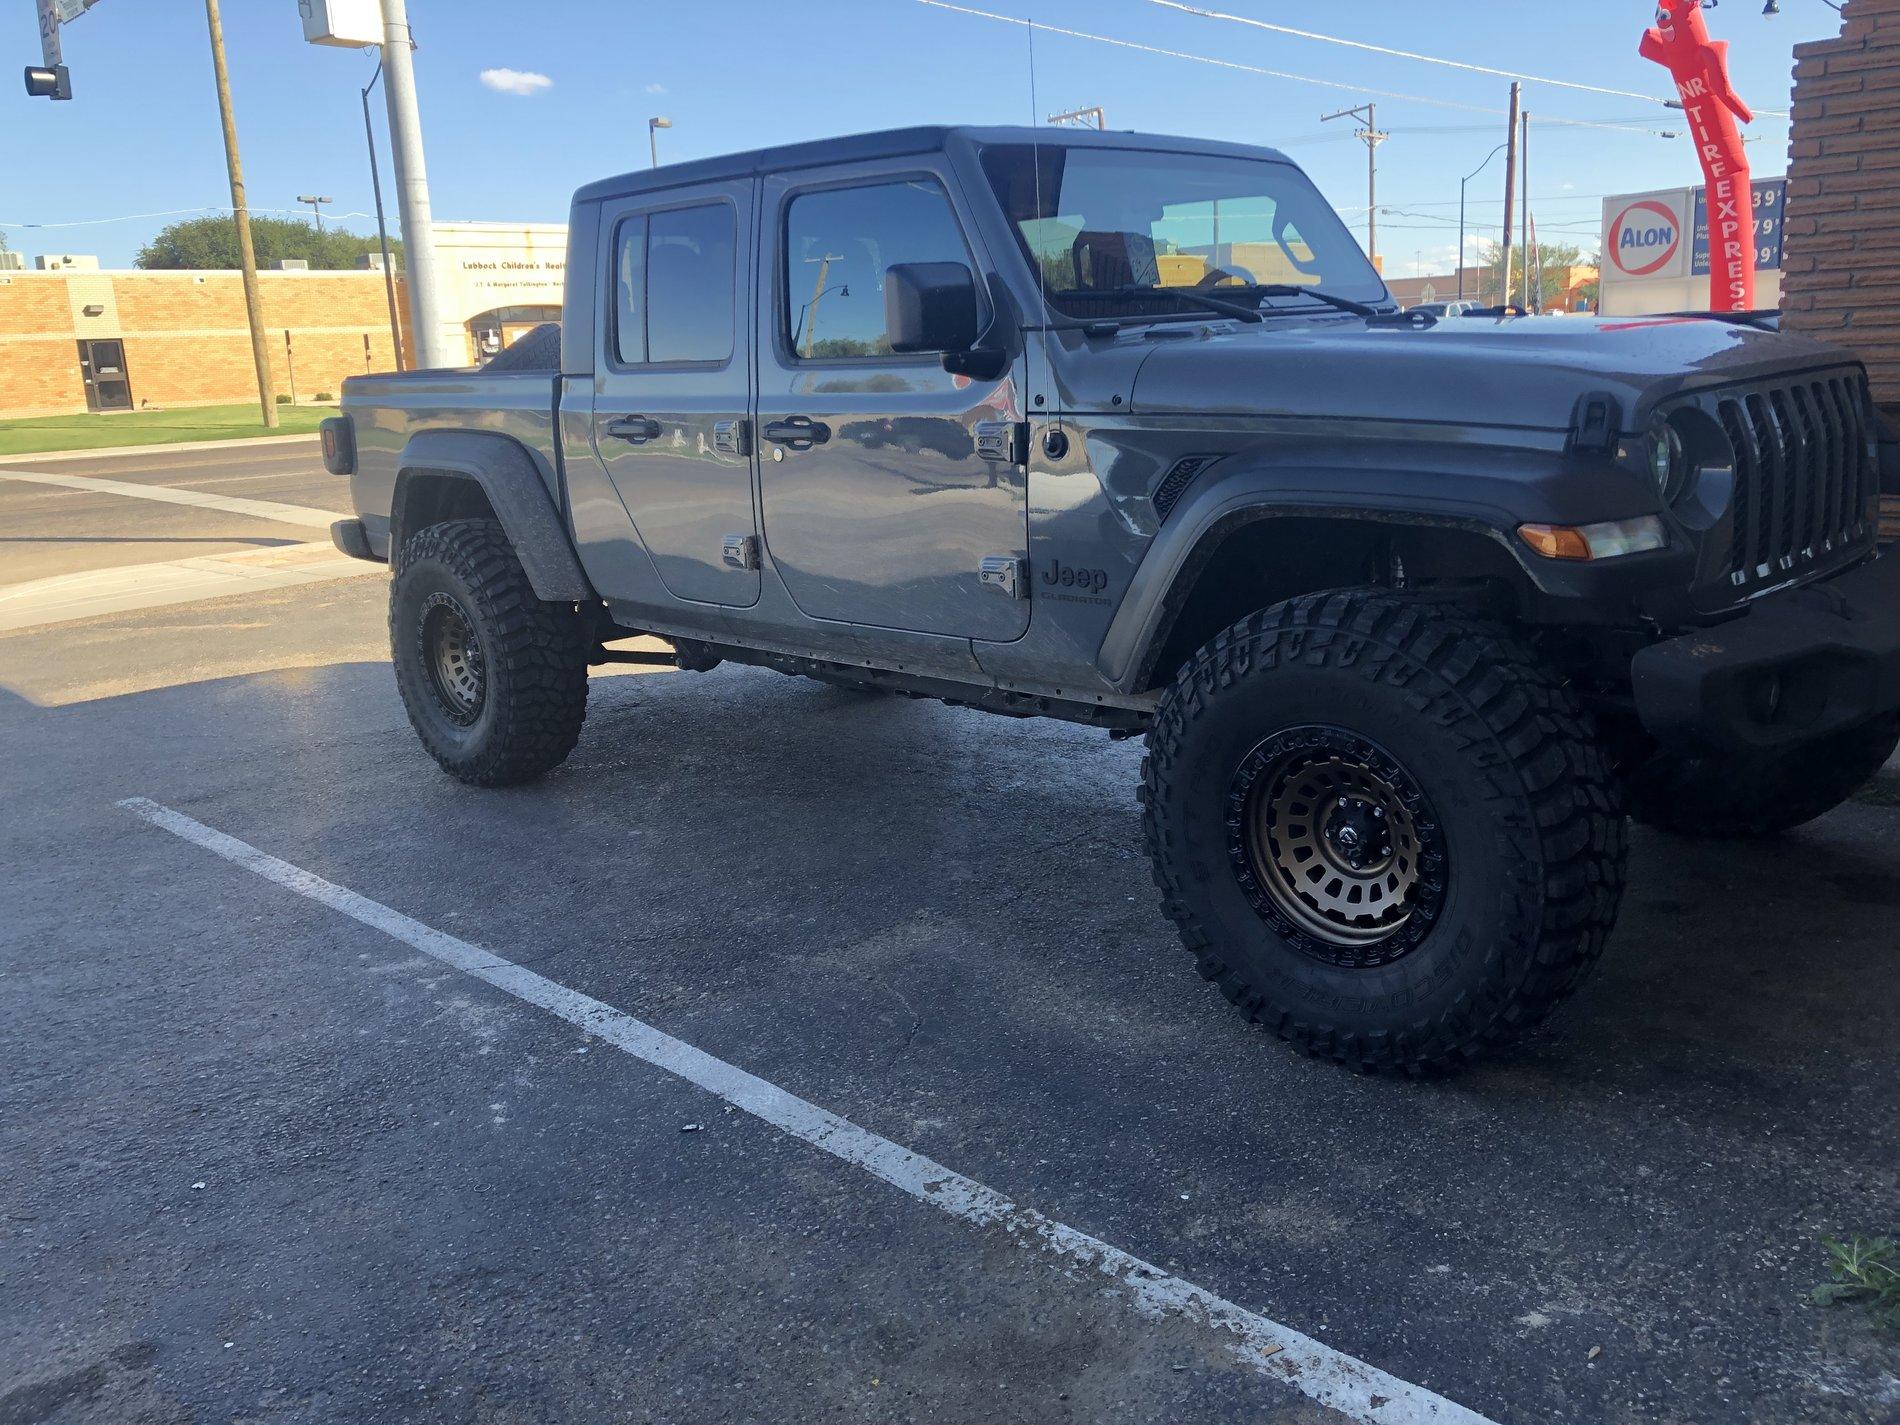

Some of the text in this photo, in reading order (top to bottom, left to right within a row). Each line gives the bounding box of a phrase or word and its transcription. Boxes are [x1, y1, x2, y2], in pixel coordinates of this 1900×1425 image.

[1689, 105, 1725, 178] TIRE
[1620, 227, 1672, 248] ALON
[463, 261, 497, 270] Lubbock
[501, 261, 540, 270] Children's
[1042, 559, 1107, 594] Jeep
